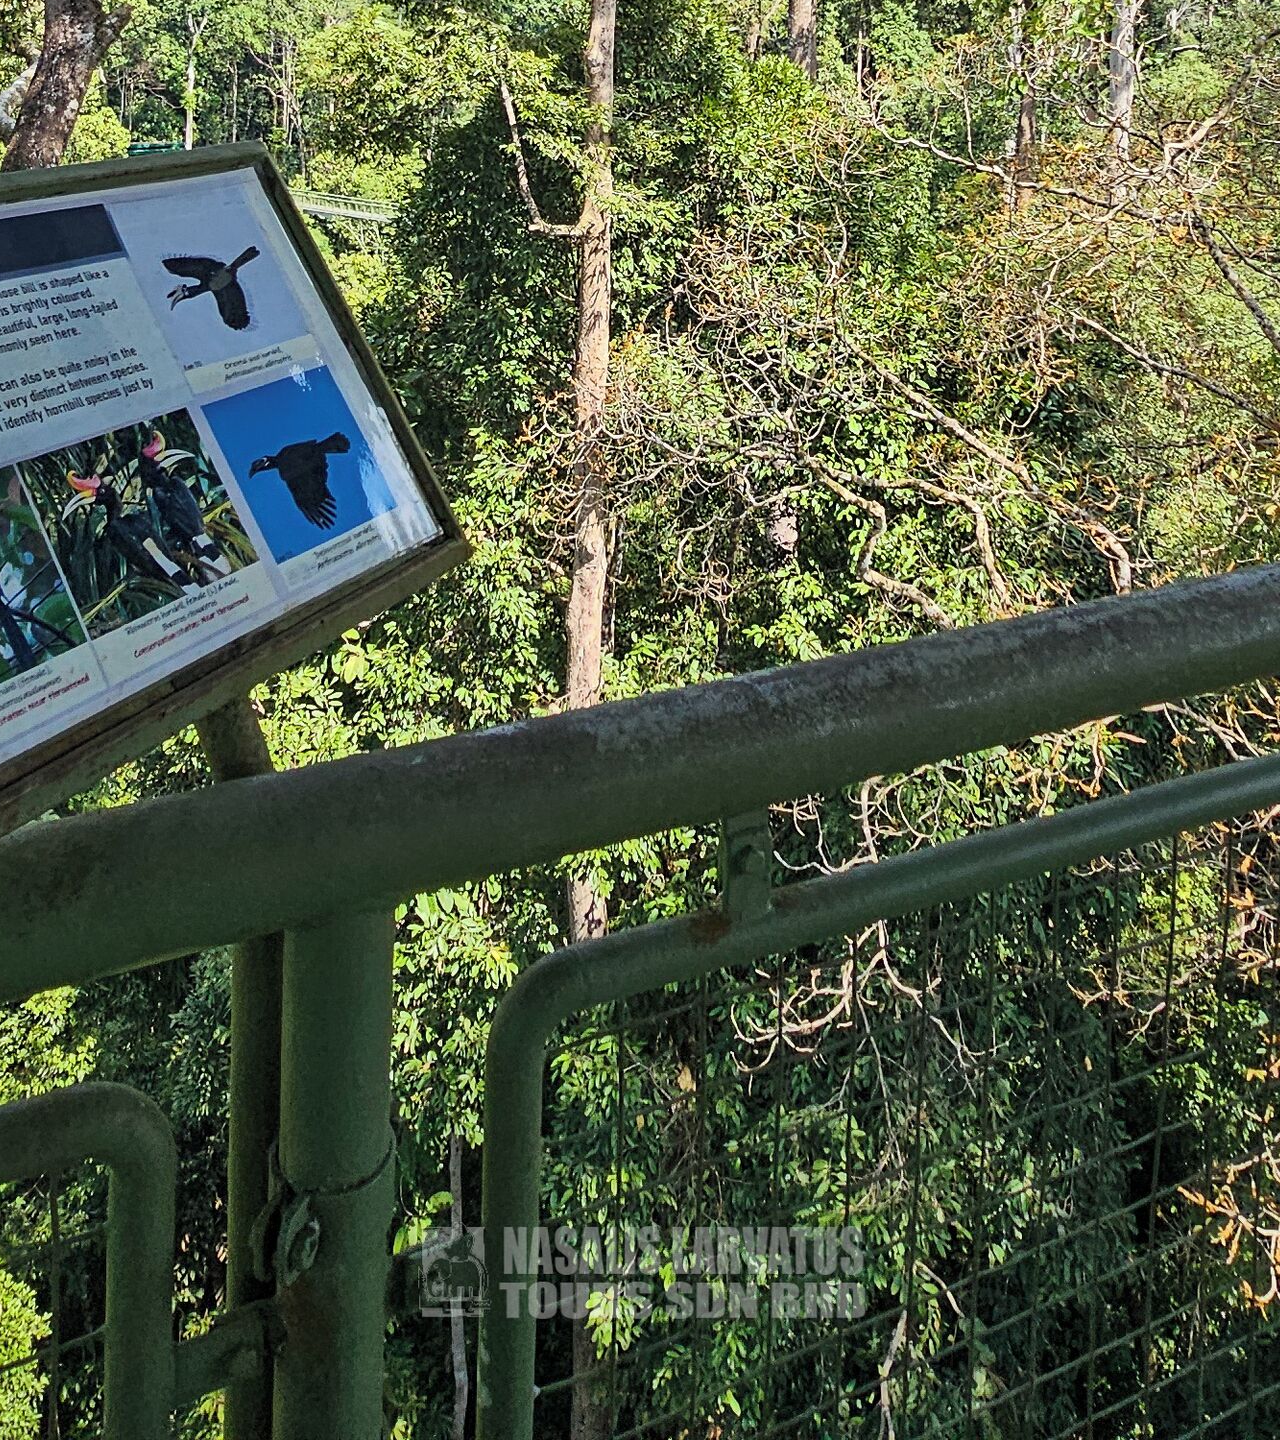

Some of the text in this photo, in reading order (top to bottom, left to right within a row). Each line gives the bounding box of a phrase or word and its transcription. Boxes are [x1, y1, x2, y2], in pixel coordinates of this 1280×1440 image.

[20, 282, 37, 294] bill
[39, 282, 48, 290] is
[49, 272, 83, 289] shaped
[83, 270, 101, 281] like
[103, 270, 109, 278] a
[0, 306, 9, 317] is
[12, 298, 49, 314] brightly
[51, 287, 94, 304] coloured.
[37, 314, 68, 326] large,
[70, 300, 118, 320] long-tailed
[29, 333, 54, 347] seen
[55, 326, 81, 340] here.
[0, 379, 18, 392] can
[20, 369, 42, 386] also
[45, 366, 56, 379] be
[58, 361, 82, 376] quite
[84, 354, 110, 369] noisy
[108, 351, 119, 361] in
[120, 346, 137, 359] the
[4, 395, 28, 410] very
[30, 384, 67, 402] distinct
[69, 373, 109, 391] between
[110, 361, 148, 381] species.
[4, 409, 44, 430] identify
[45, 397, 85, 417] hornbill
[85, 387, 121, 405] species
[122, 381, 141, 397] just
[141, 377, 154, 390] by
